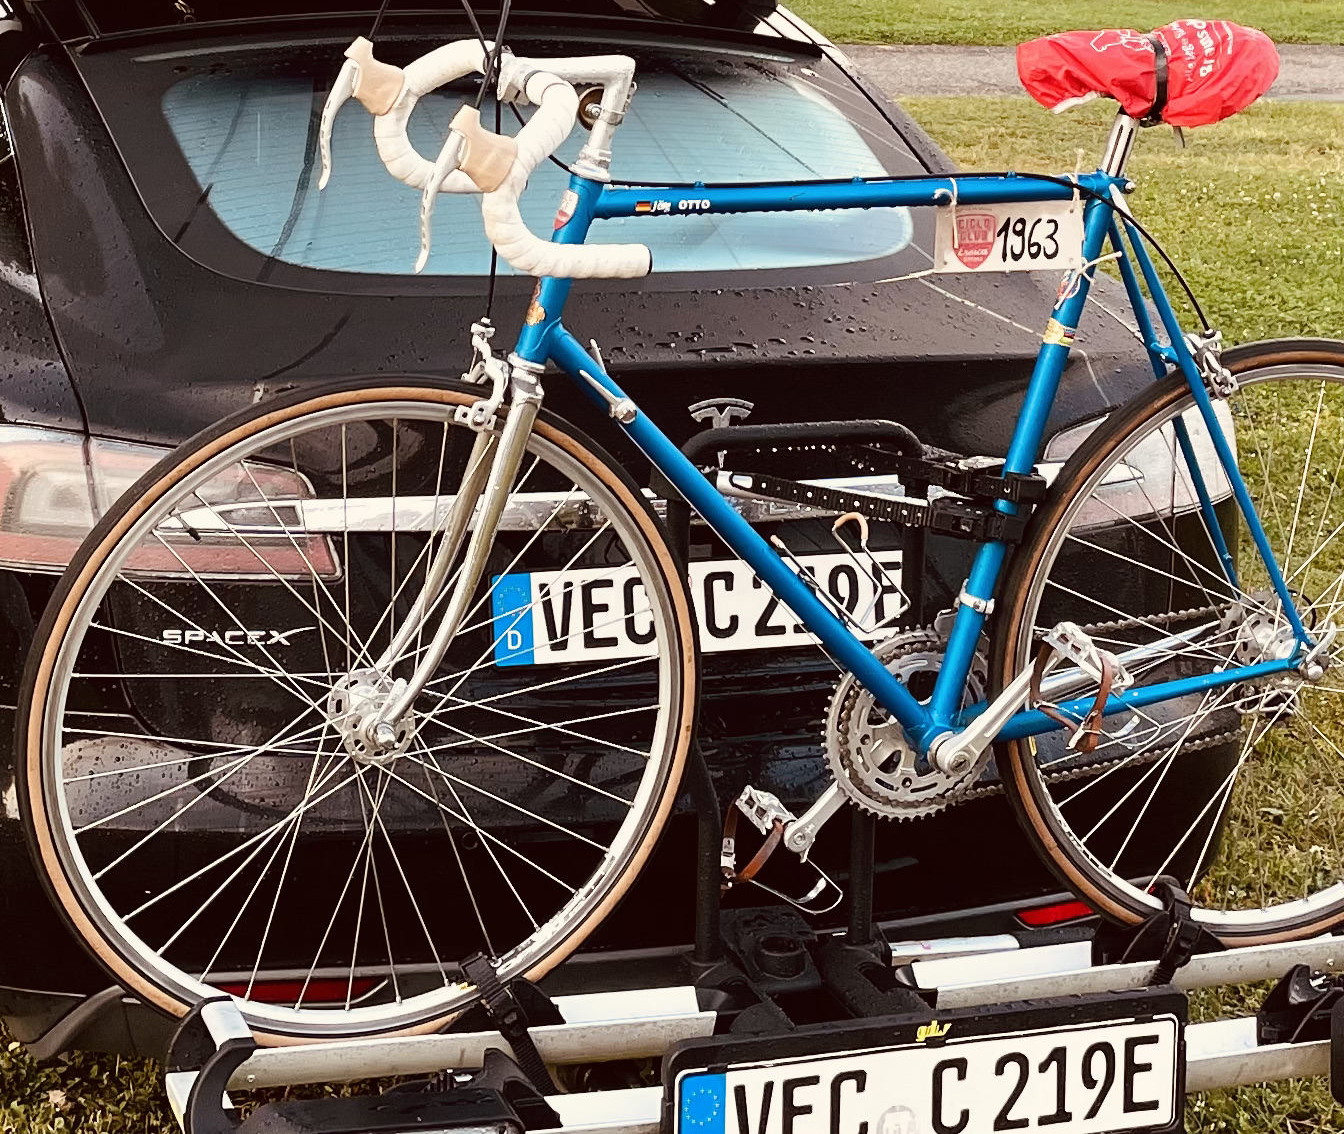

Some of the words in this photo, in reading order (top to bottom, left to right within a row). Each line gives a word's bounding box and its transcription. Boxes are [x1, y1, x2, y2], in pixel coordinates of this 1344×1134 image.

[678, 199, 711, 210] OTTO
[997, 216, 1059, 262] 1963
[538, 577, 656, 652] VEC
[702, 570, 741, 639] C
[753, 561, 903, 636] 29E
[162, 626, 317, 646] SPACEX
[507, 629, 522, 651] D
[734, 1070, 868, 1133] VEC
[932, 1057, 969, 1133] C
[993, 1034, 1160, 1132] 219E
